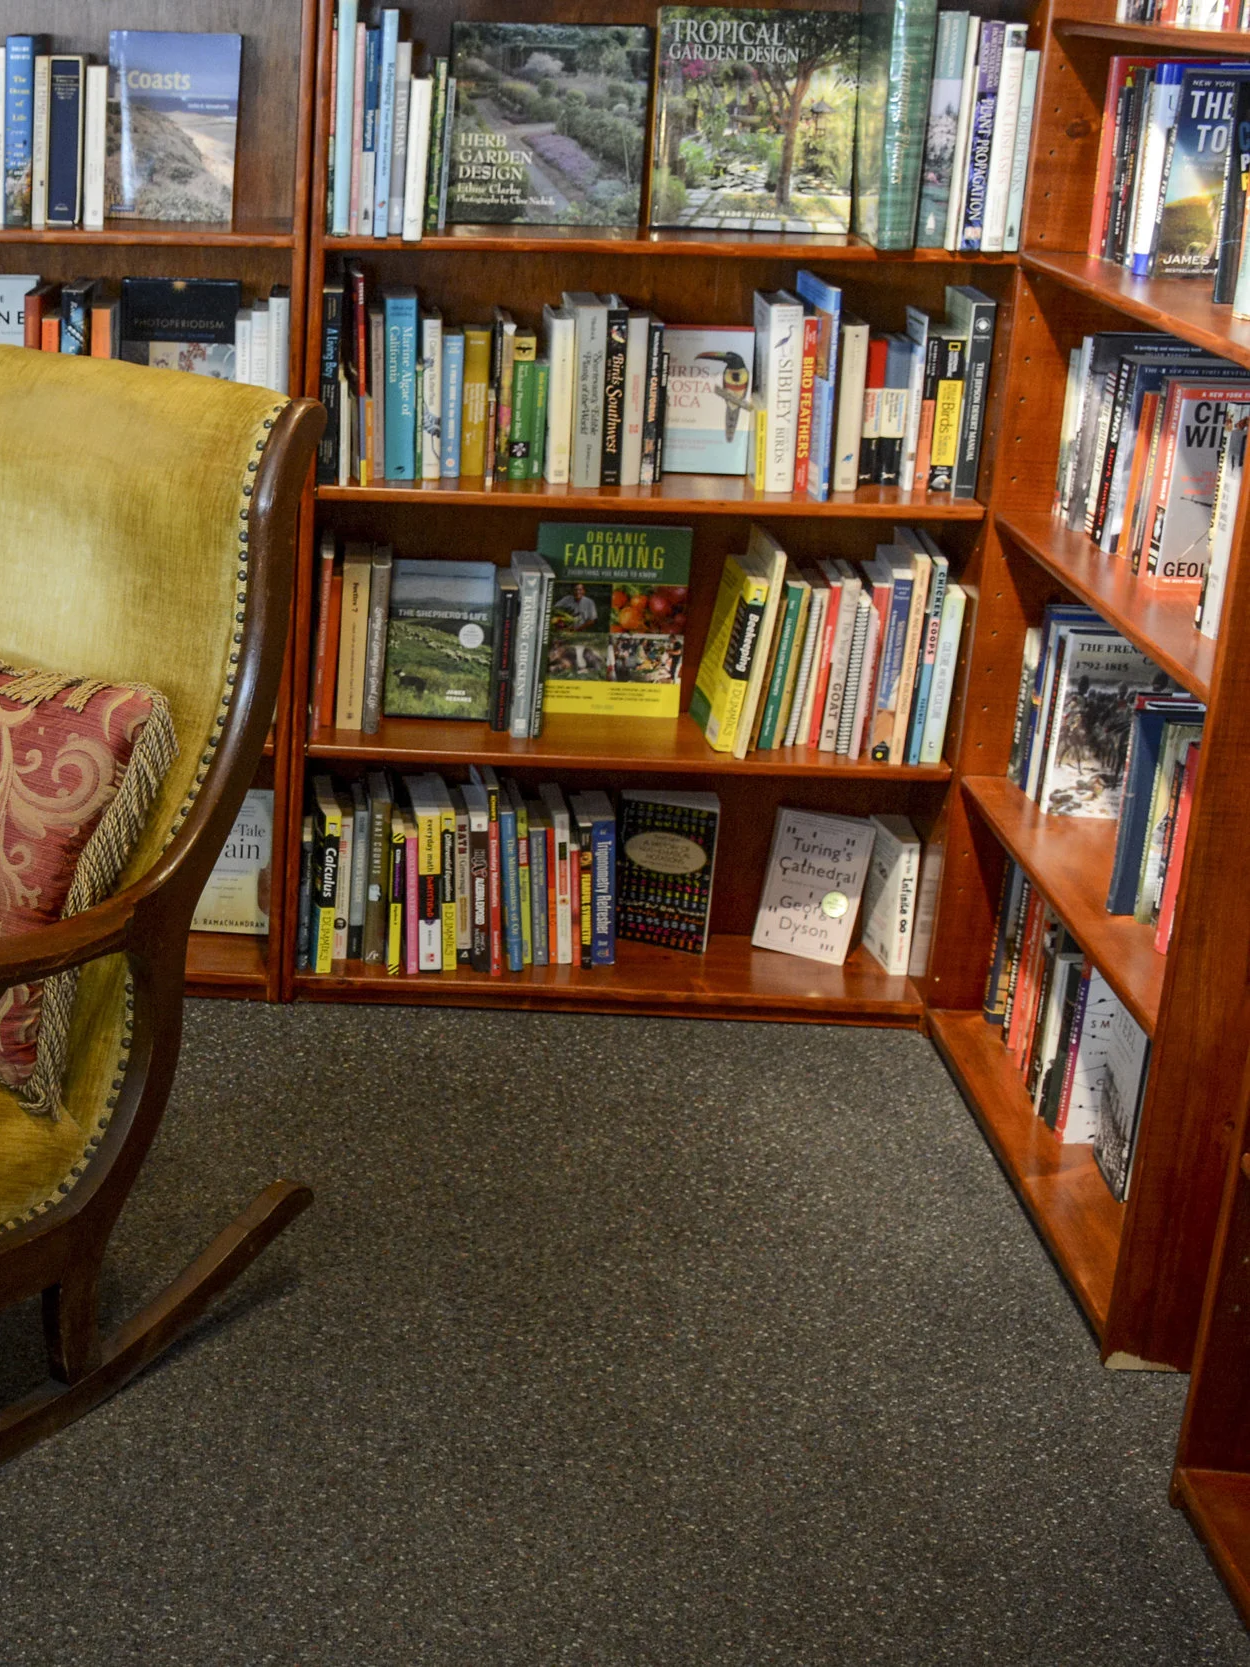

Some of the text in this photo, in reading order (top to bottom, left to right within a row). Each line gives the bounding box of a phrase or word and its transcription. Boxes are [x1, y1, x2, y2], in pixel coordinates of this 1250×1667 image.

[671, 19, 785, 46] TROPICAL
[669, 42, 801, 64] GARDEN DESIGN
[127, 70, 191, 90] Coasts
[394, 89, 407, 155] LEWISIAS
[1190, 90, 1233, 120] THE
[365, 110, 374, 148] Hydrangeas
[460, 132, 507, 148] HERB
[1196, 124, 1227, 153] TO
[458, 165, 524, 181] DESIGN
[459, 149, 533, 165] GARDEN
[969, 99, 994, 221] PLANT PROPAGATION
[1163, 147, 1175, 177] ROAD
[1161, 180, 1168, 193] TO
[1156, 195, 1166, 224] RUIN
[1163, 253, 1210, 266] JAMES
[133, 318, 226, 330] PHOTOPERIODISM
[324, 336, 338, 360] Living
[389, 326, 400, 383] California
[322, 362, 337, 378] Bay
[399, 326, 412, 416] Marine Algae of
[1117, 363, 1129, 400] Hue
[605, 353, 625, 454] Birds Southwest
[647, 377, 658, 422] CALIFORNIA
[776, 358, 793, 424] SIBLEY
[797, 356, 815, 459] BIRD FEATHERS
[938, 402, 956, 434] Birds
[965, 362, 985, 462] THE JEPSON DESERT MANUAL
[1109, 406, 1123, 443] 1968
[774, 427, 785, 464] BIRDS
[1160, 479, 1169, 501] WAR
[564, 543, 666, 569] FARMING
[586, 530, 647, 545] ORGANIC
[399, 609, 414, 617] THE
[469, 613, 488, 621] LIFE
[542, 581, 554, 645] TOGETHER RESILIENT
[927, 571, 946, 656] CHICKEN COOPS
[516, 595, 532, 697] RAISING CHICKENS
[735, 613, 760, 673] Beekeeping
[1079, 642, 1103, 652] THE
[1075, 661, 1130, 673] 1792-1815
[724, 689, 741, 737] DUMMIES
[827, 683, 842, 720] GOAT
[372, 814, 383, 874] WHAT COUNTS
[422, 819, 435, 873] everyday math
[457, 824, 466, 855] MATH
[793, 836, 853, 863] Turing's
[322, 847, 337, 898] Calculus
[444, 833, 453, 901] Differential Equations
[490, 839, 499, 907] Elementary Mathematics
[779, 856, 858, 884] Cathedral
[507, 839, 519, 935] The Mathematics of Oz
[596, 841, 613, 935] Trigonometry Refresher
[581, 873, 591, 945] FEARFUL SYMMETRY
[779, 916, 829, 939] Dyson
[320, 917, 332, 961] DUMMIES
